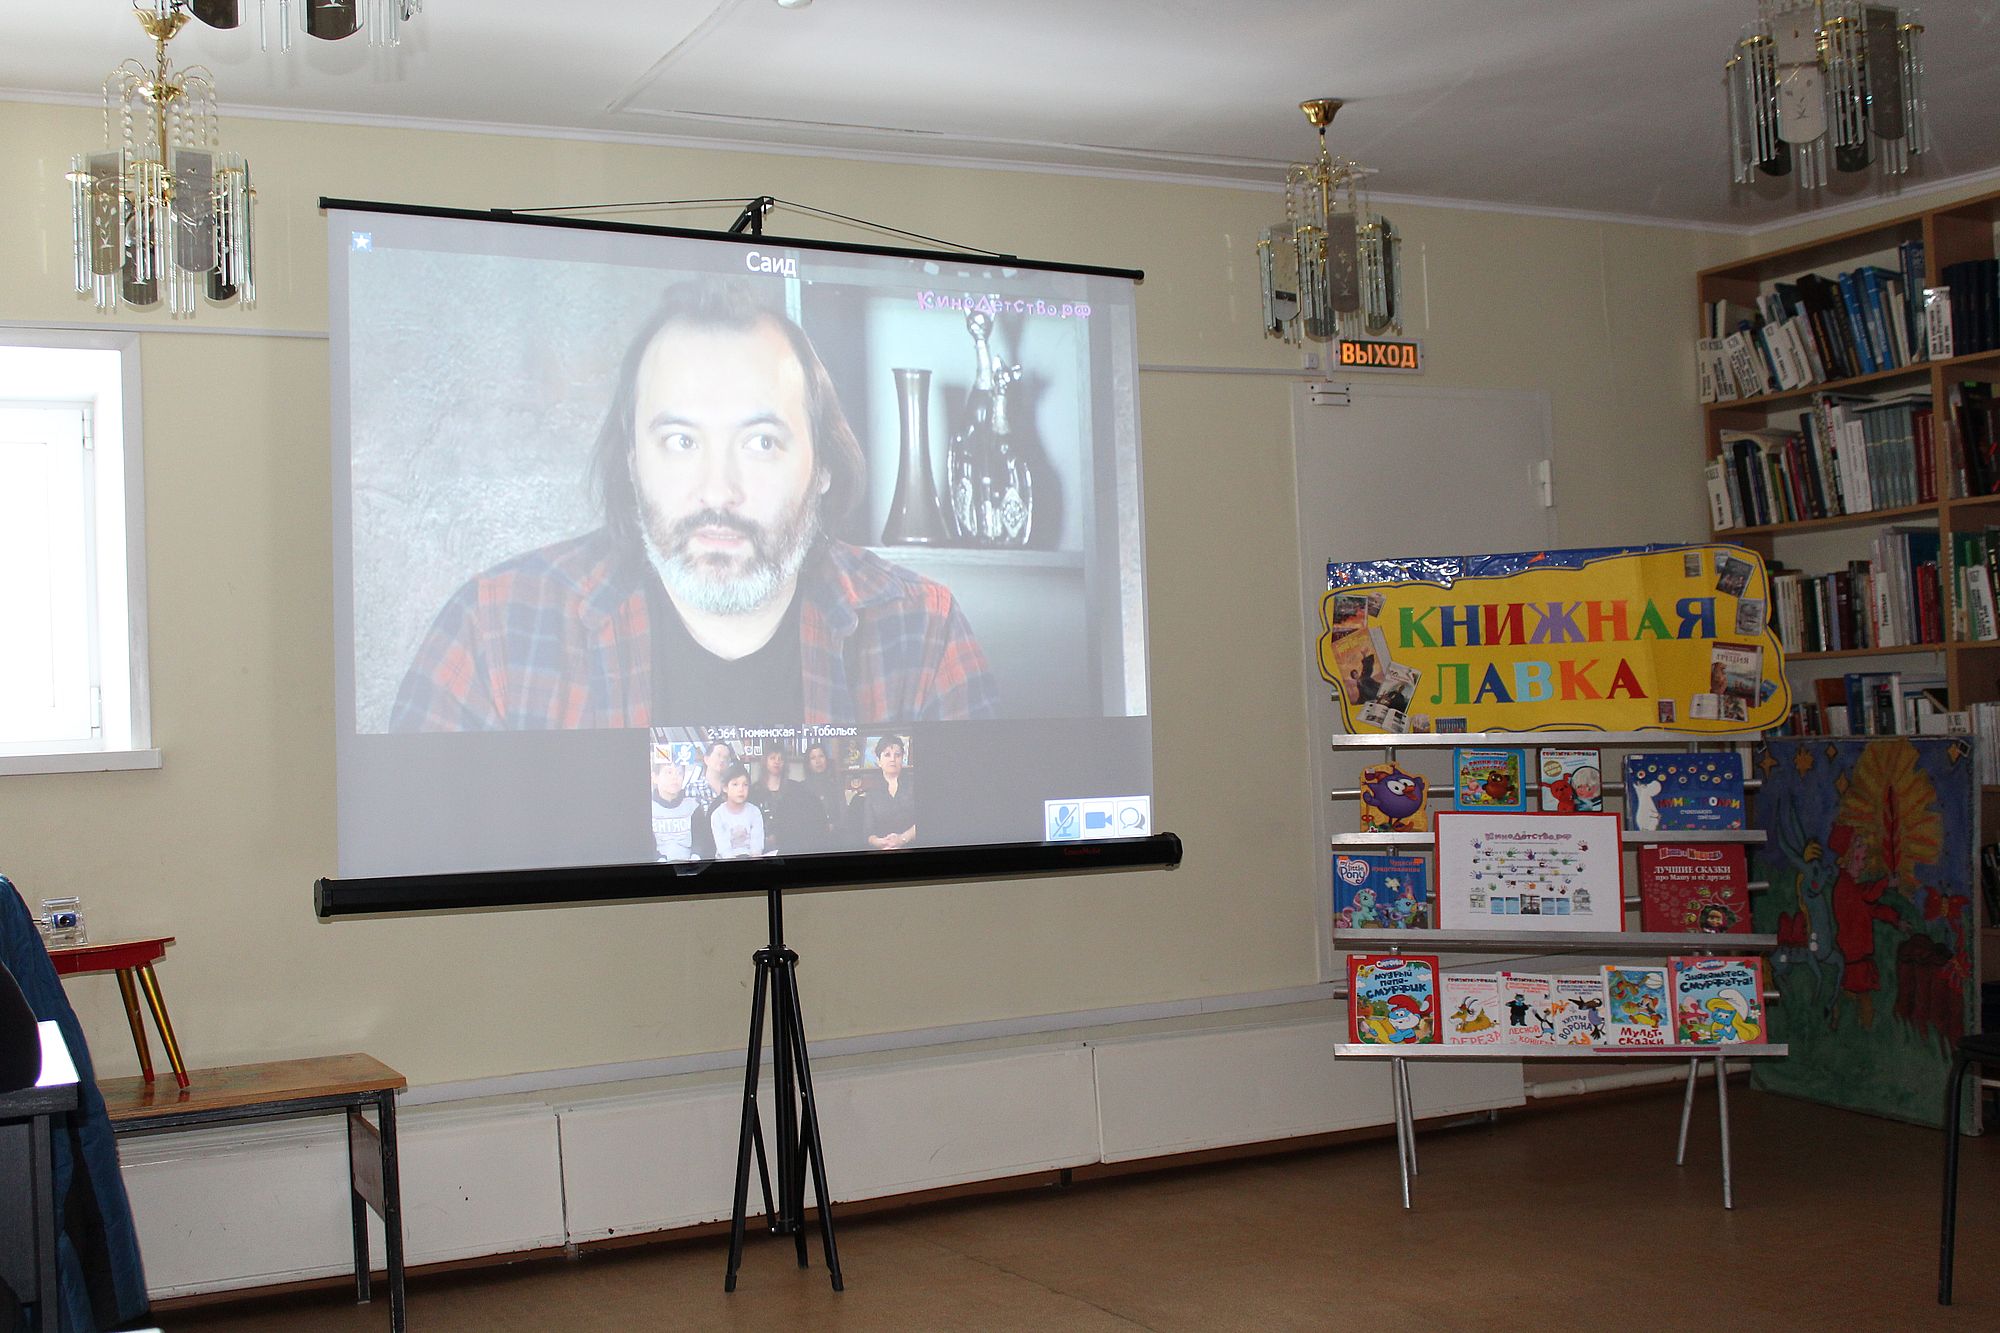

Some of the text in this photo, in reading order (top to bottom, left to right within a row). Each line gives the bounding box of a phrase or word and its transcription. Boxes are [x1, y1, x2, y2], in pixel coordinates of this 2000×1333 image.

[745, 251, 797, 277] Саид
[1342, 342, 1416, 369] ВЫХОД
[1398, 596, 1718, 649] КНИЖНАЯ
[1430, 657, 1649, 705] ЛАВКА
[739, 727, 795, 738] Тюменская
[1653, 866, 1731, 874] ЛУЧШИЕ СКАЗКИ
[1508, 1023, 1541, 1036] ЛЕСНОЙ
[1558, 1020, 1593, 1040] ВОРОНА
